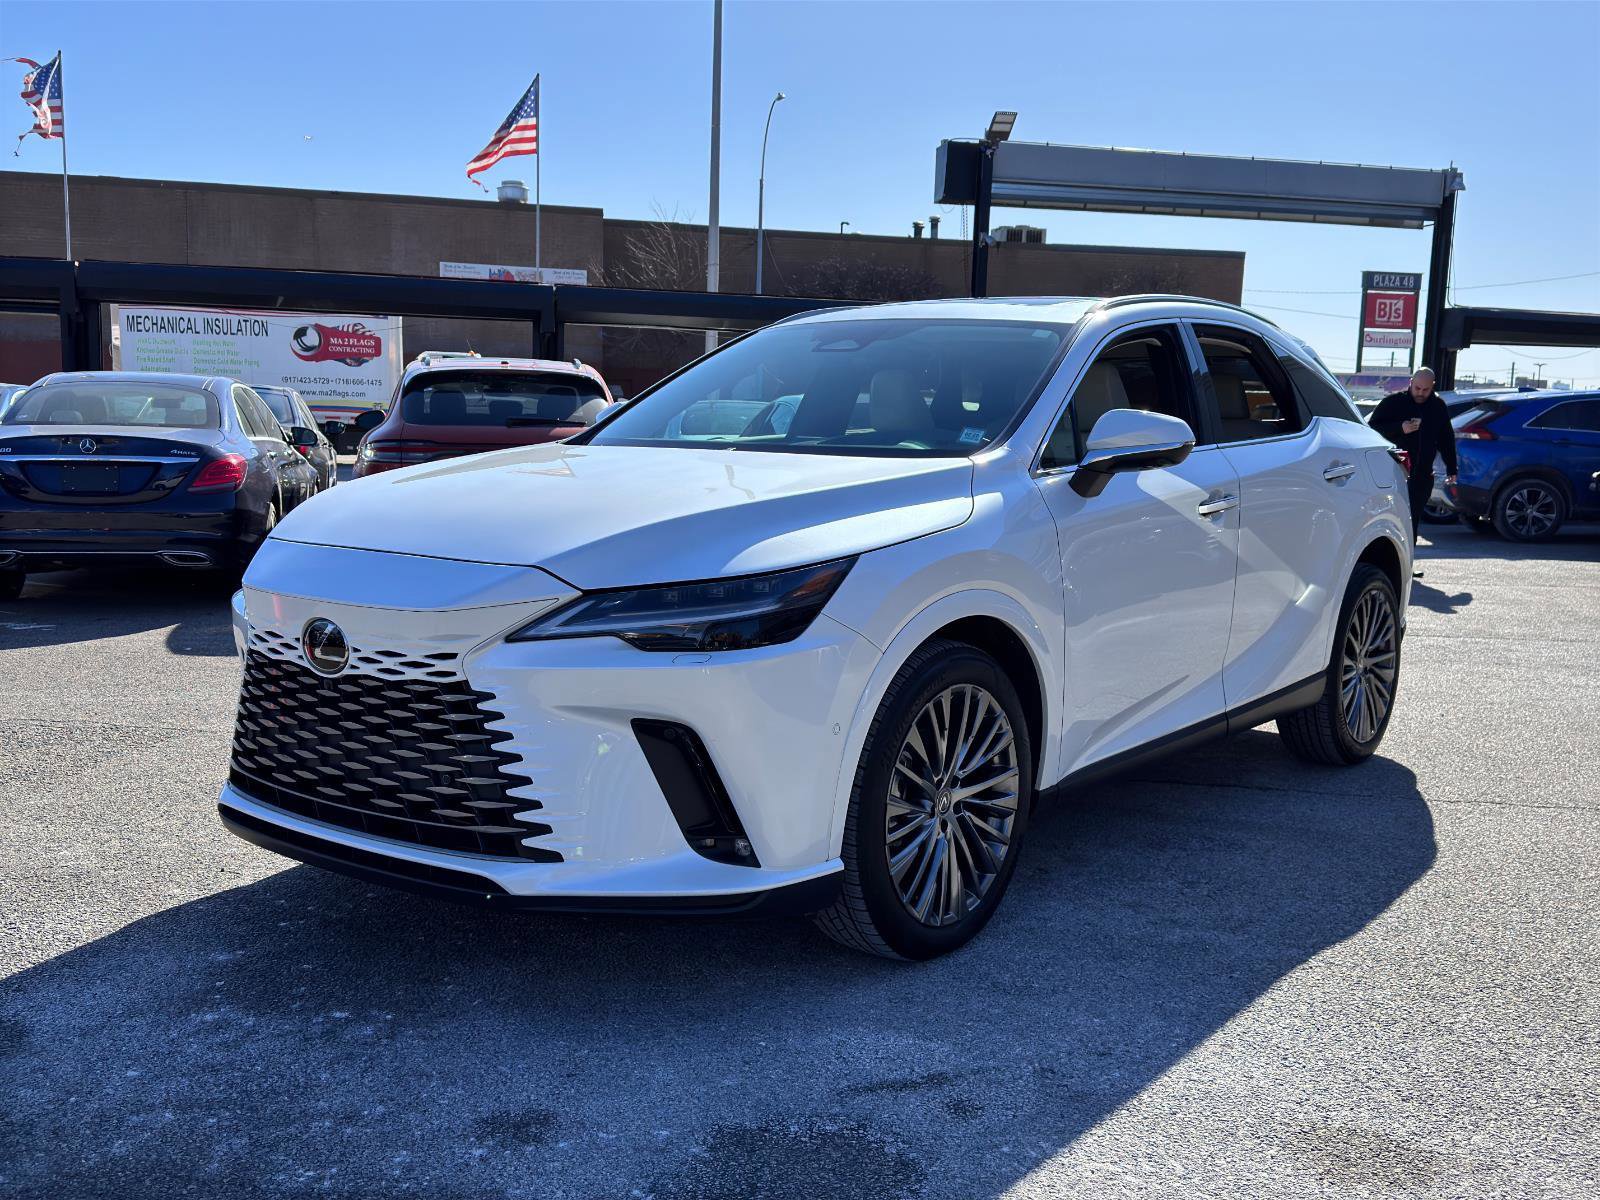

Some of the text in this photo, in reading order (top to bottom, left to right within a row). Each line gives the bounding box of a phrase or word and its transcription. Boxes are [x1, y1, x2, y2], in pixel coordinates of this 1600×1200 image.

[1373, 274, 1415, 288] PLAZA 48
[126, 315, 269, 336] MECHANICAL INSULATION
[329, 337, 343, 345] MA
[1364, 333, 1412, 345] Burlington
[328, 345, 375, 354] CONTRACTING
[282, 376, 383, 386] (917)423-5729 (718)606-1475
[299, 388, 366, 399] www.ma2flags.com
